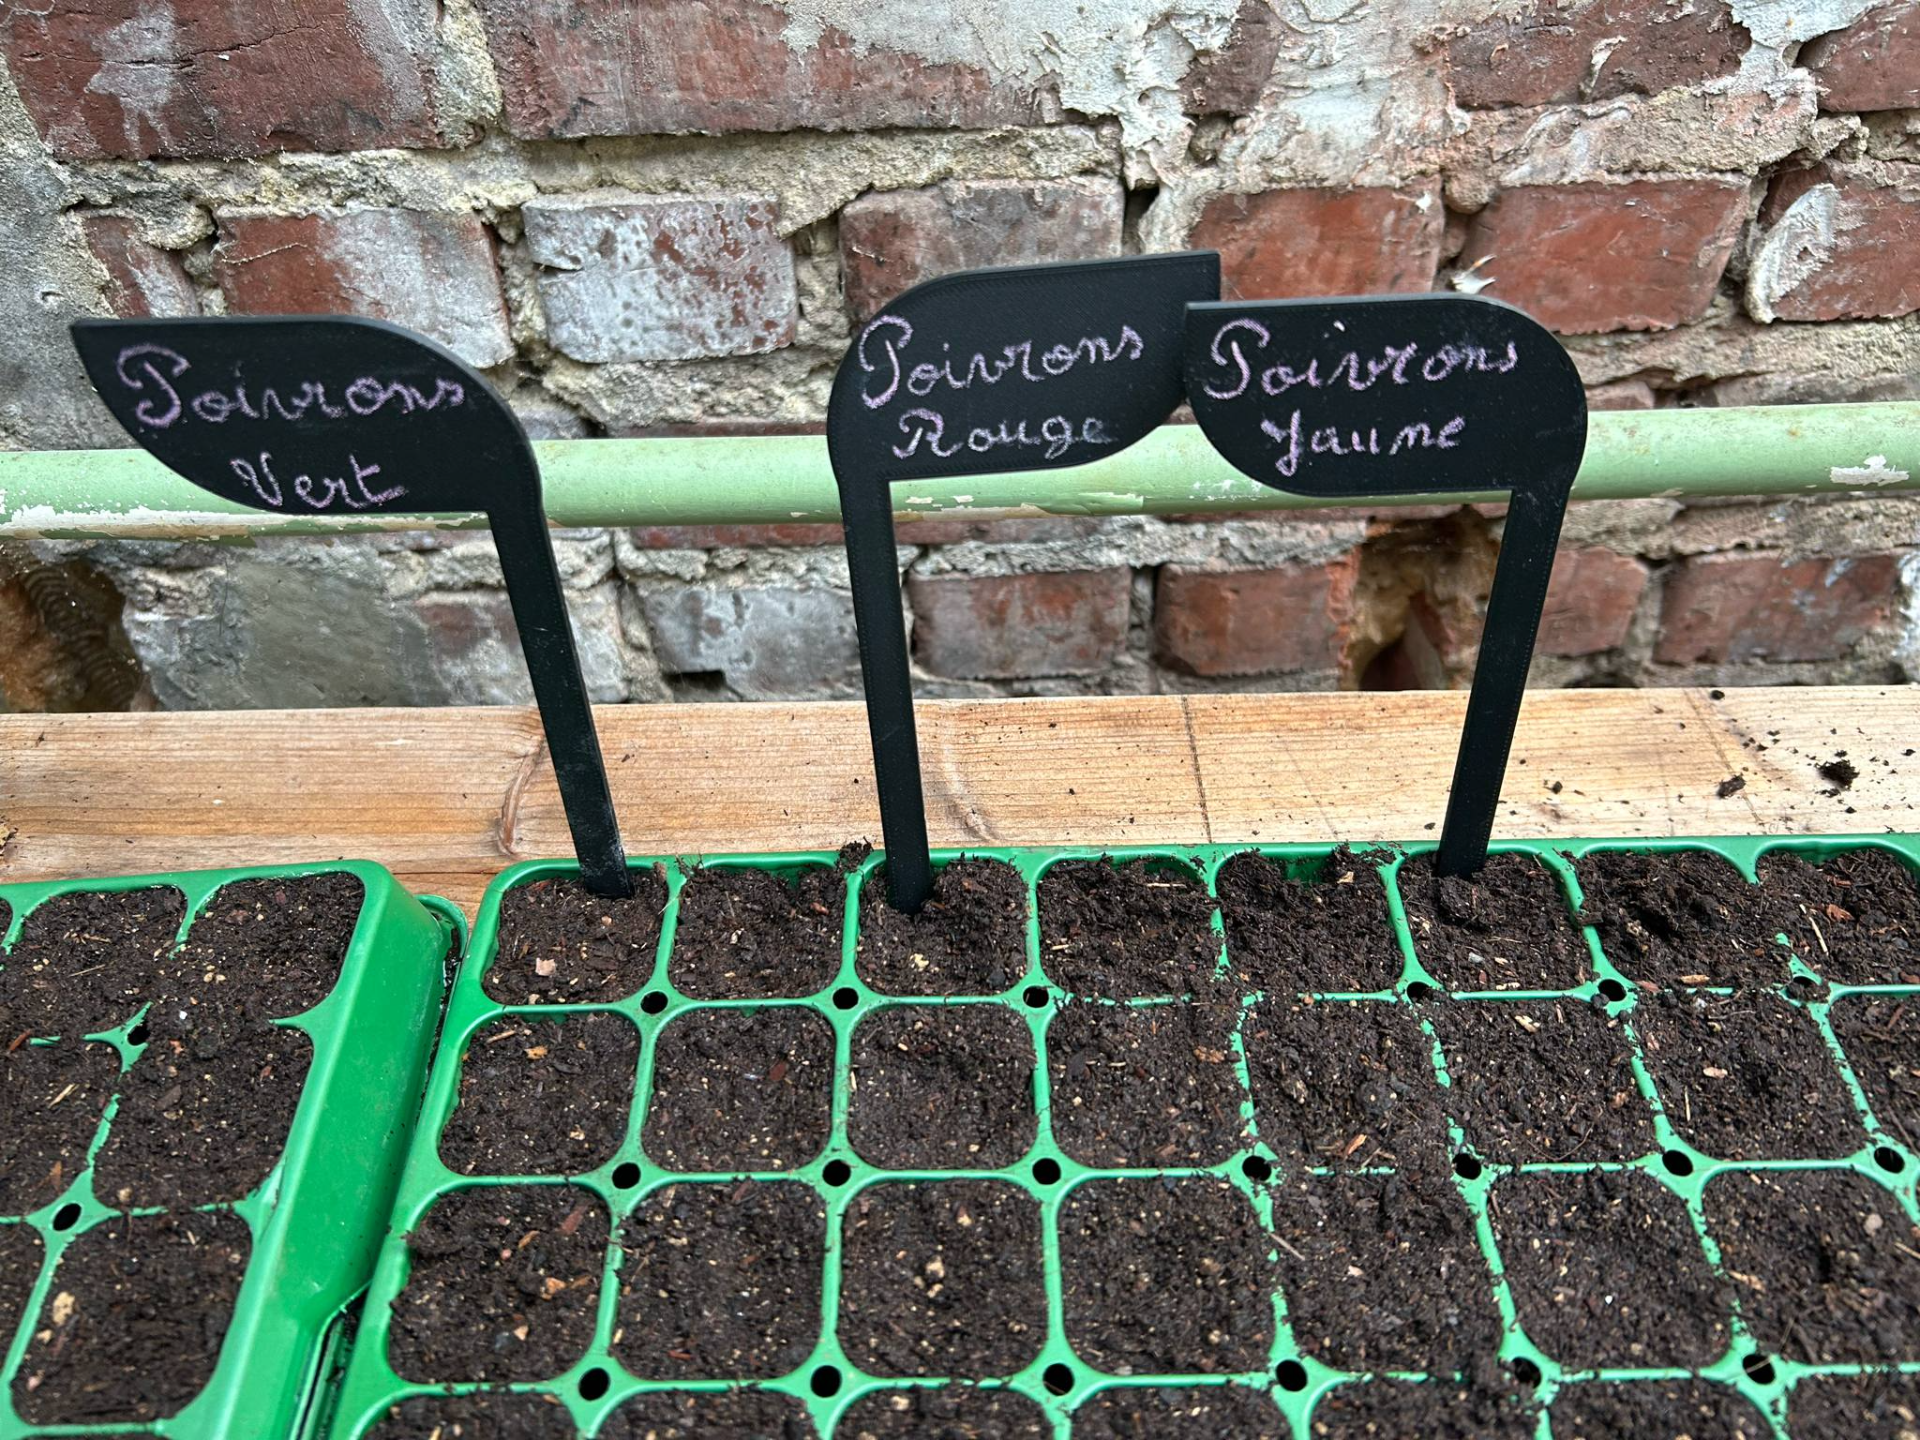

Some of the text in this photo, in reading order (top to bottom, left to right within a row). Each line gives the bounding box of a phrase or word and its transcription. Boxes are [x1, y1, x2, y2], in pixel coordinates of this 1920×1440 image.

[116, 342, 465, 428] Poivrons
[858, 314, 1145, 410] Poivrons
[1203, 317, 1520, 401] Poivrons
[892, 407, 1118, 460] Rouge
[230, 451, 407, 509] Vert
